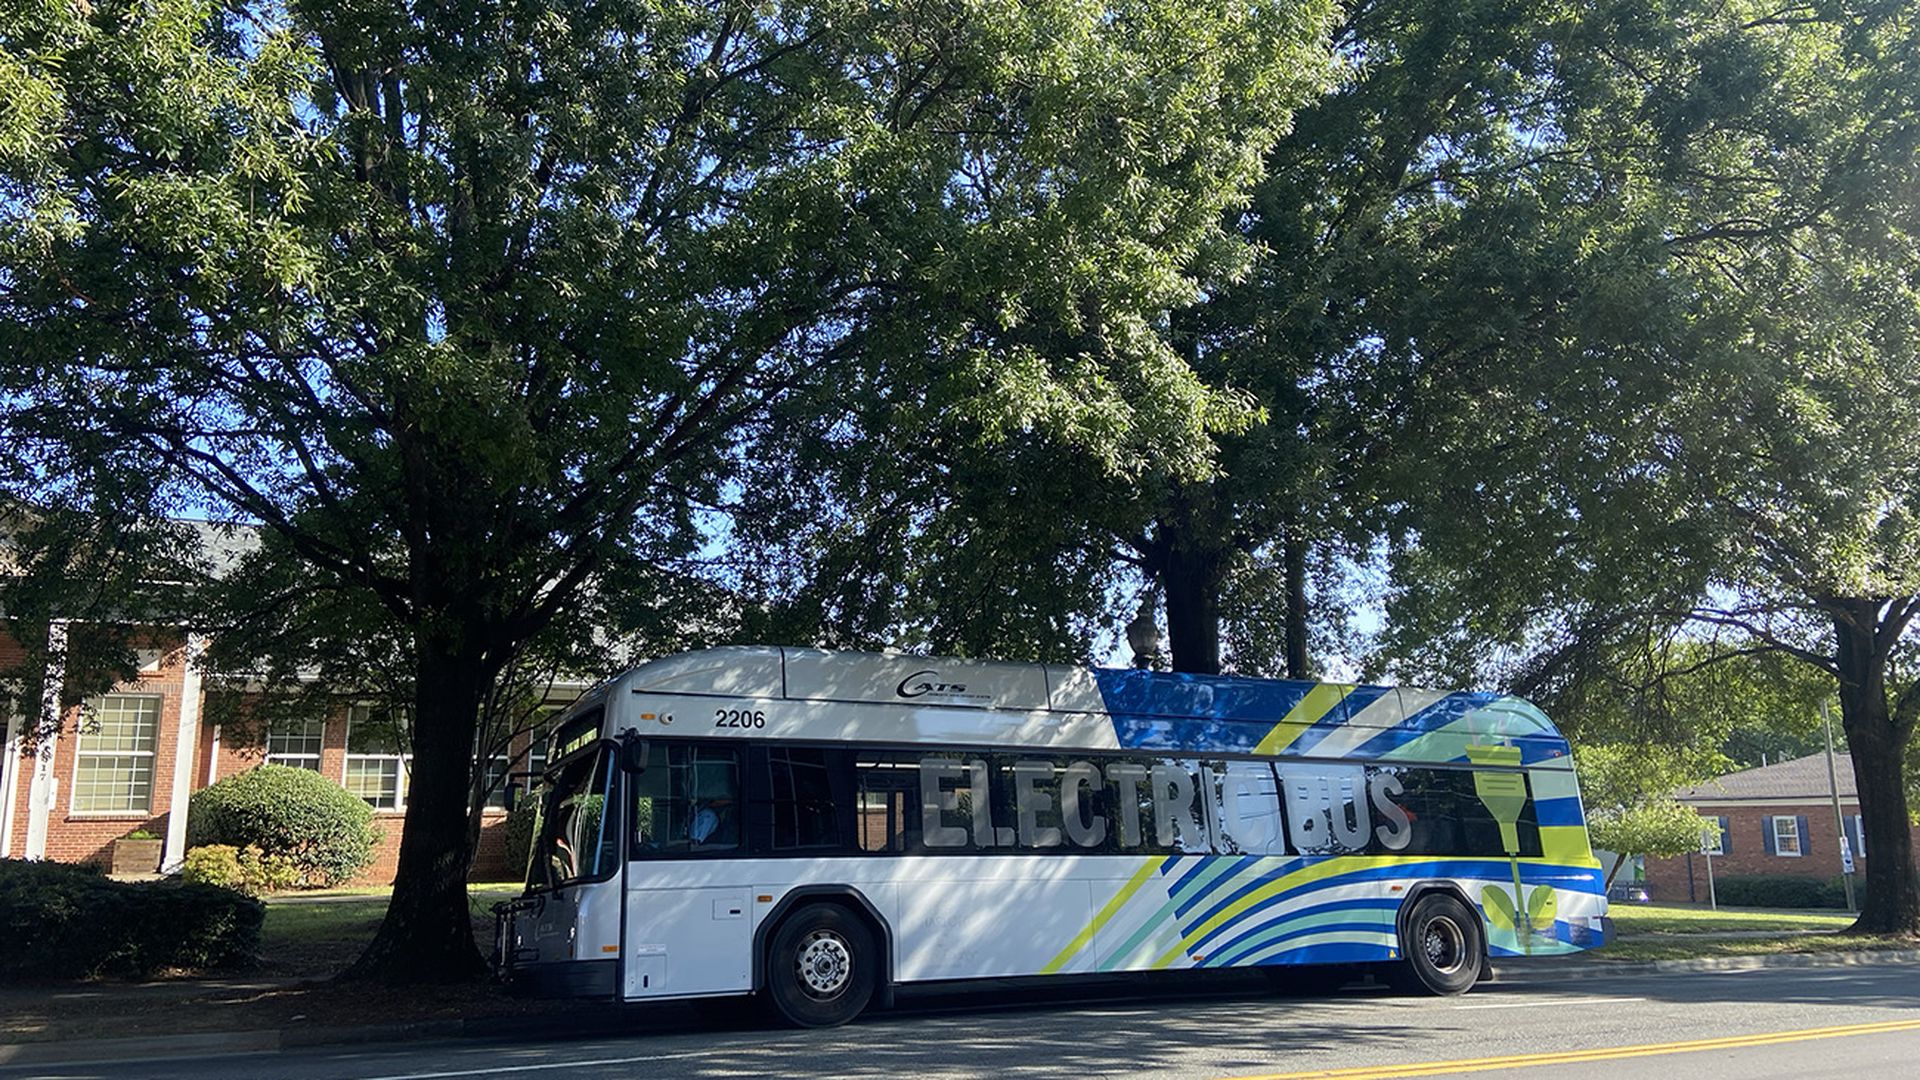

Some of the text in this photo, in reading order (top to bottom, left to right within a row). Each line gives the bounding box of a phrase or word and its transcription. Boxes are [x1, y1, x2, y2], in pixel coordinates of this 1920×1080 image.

[896, 670, 967, 699] CATS
[715, 709, 766, 729] 2206
[919, 758, 1412, 850] ELECTRIC BUS
